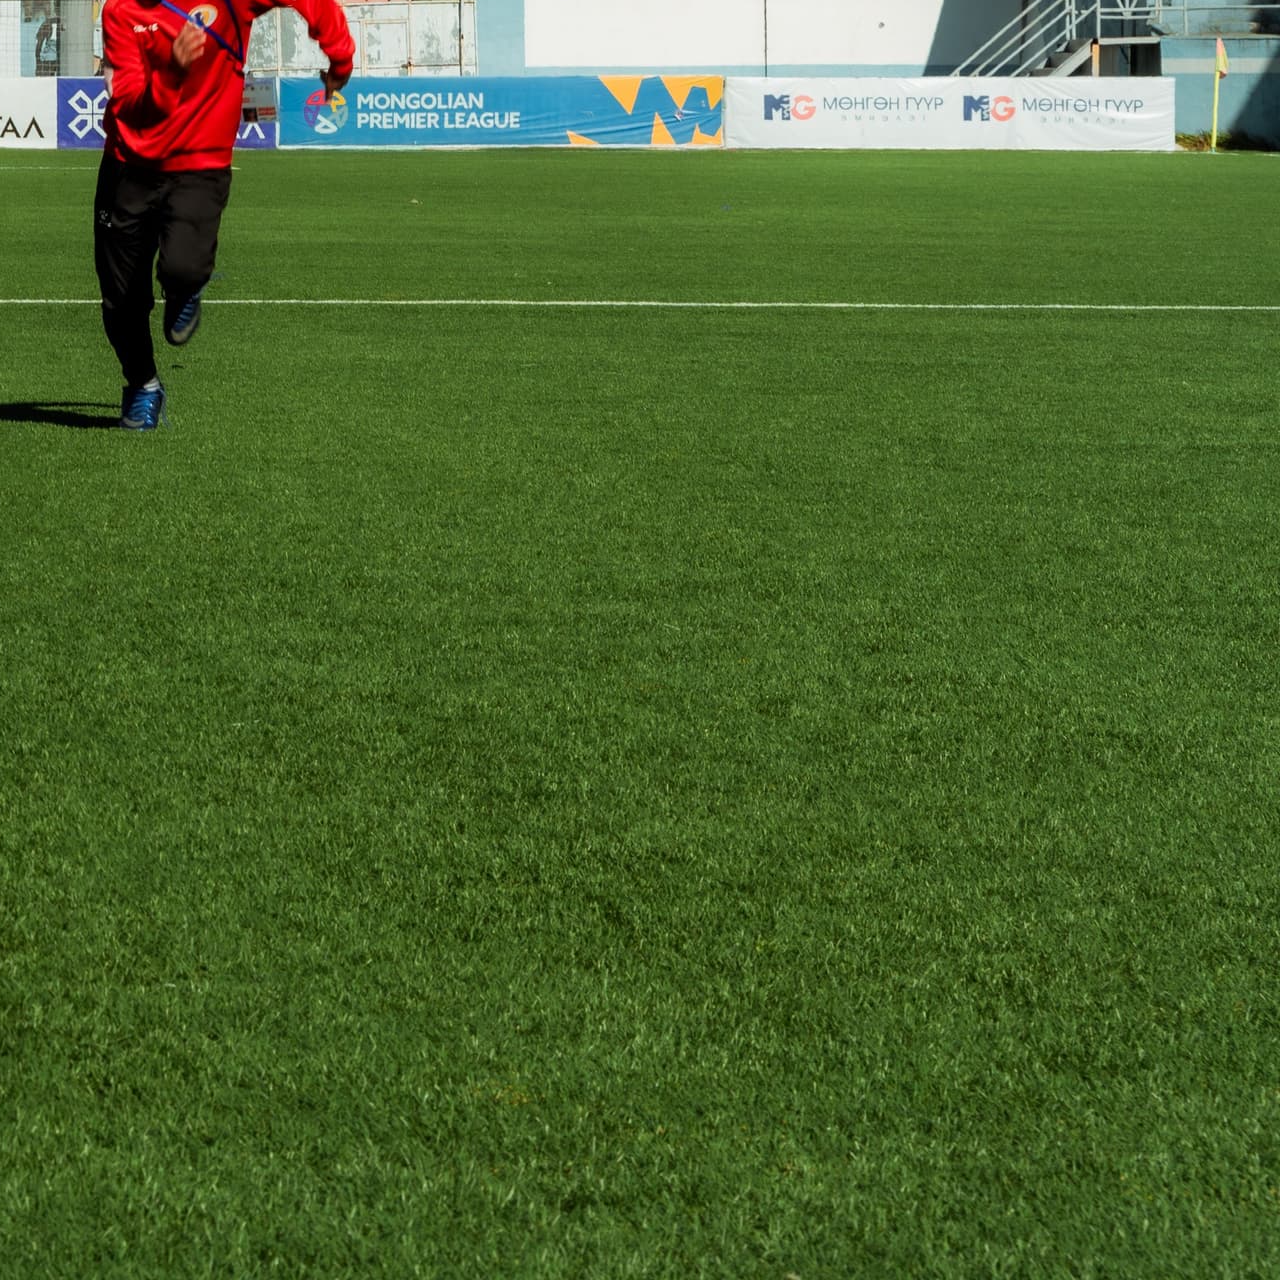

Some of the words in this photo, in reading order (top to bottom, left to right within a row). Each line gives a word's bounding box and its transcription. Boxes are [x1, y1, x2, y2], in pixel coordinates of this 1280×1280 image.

[357, 91, 484, 110] MONGOLIAN
[357, 111, 439, 129] PREMIER
[444, 111, 521, 129] LEAGUE
